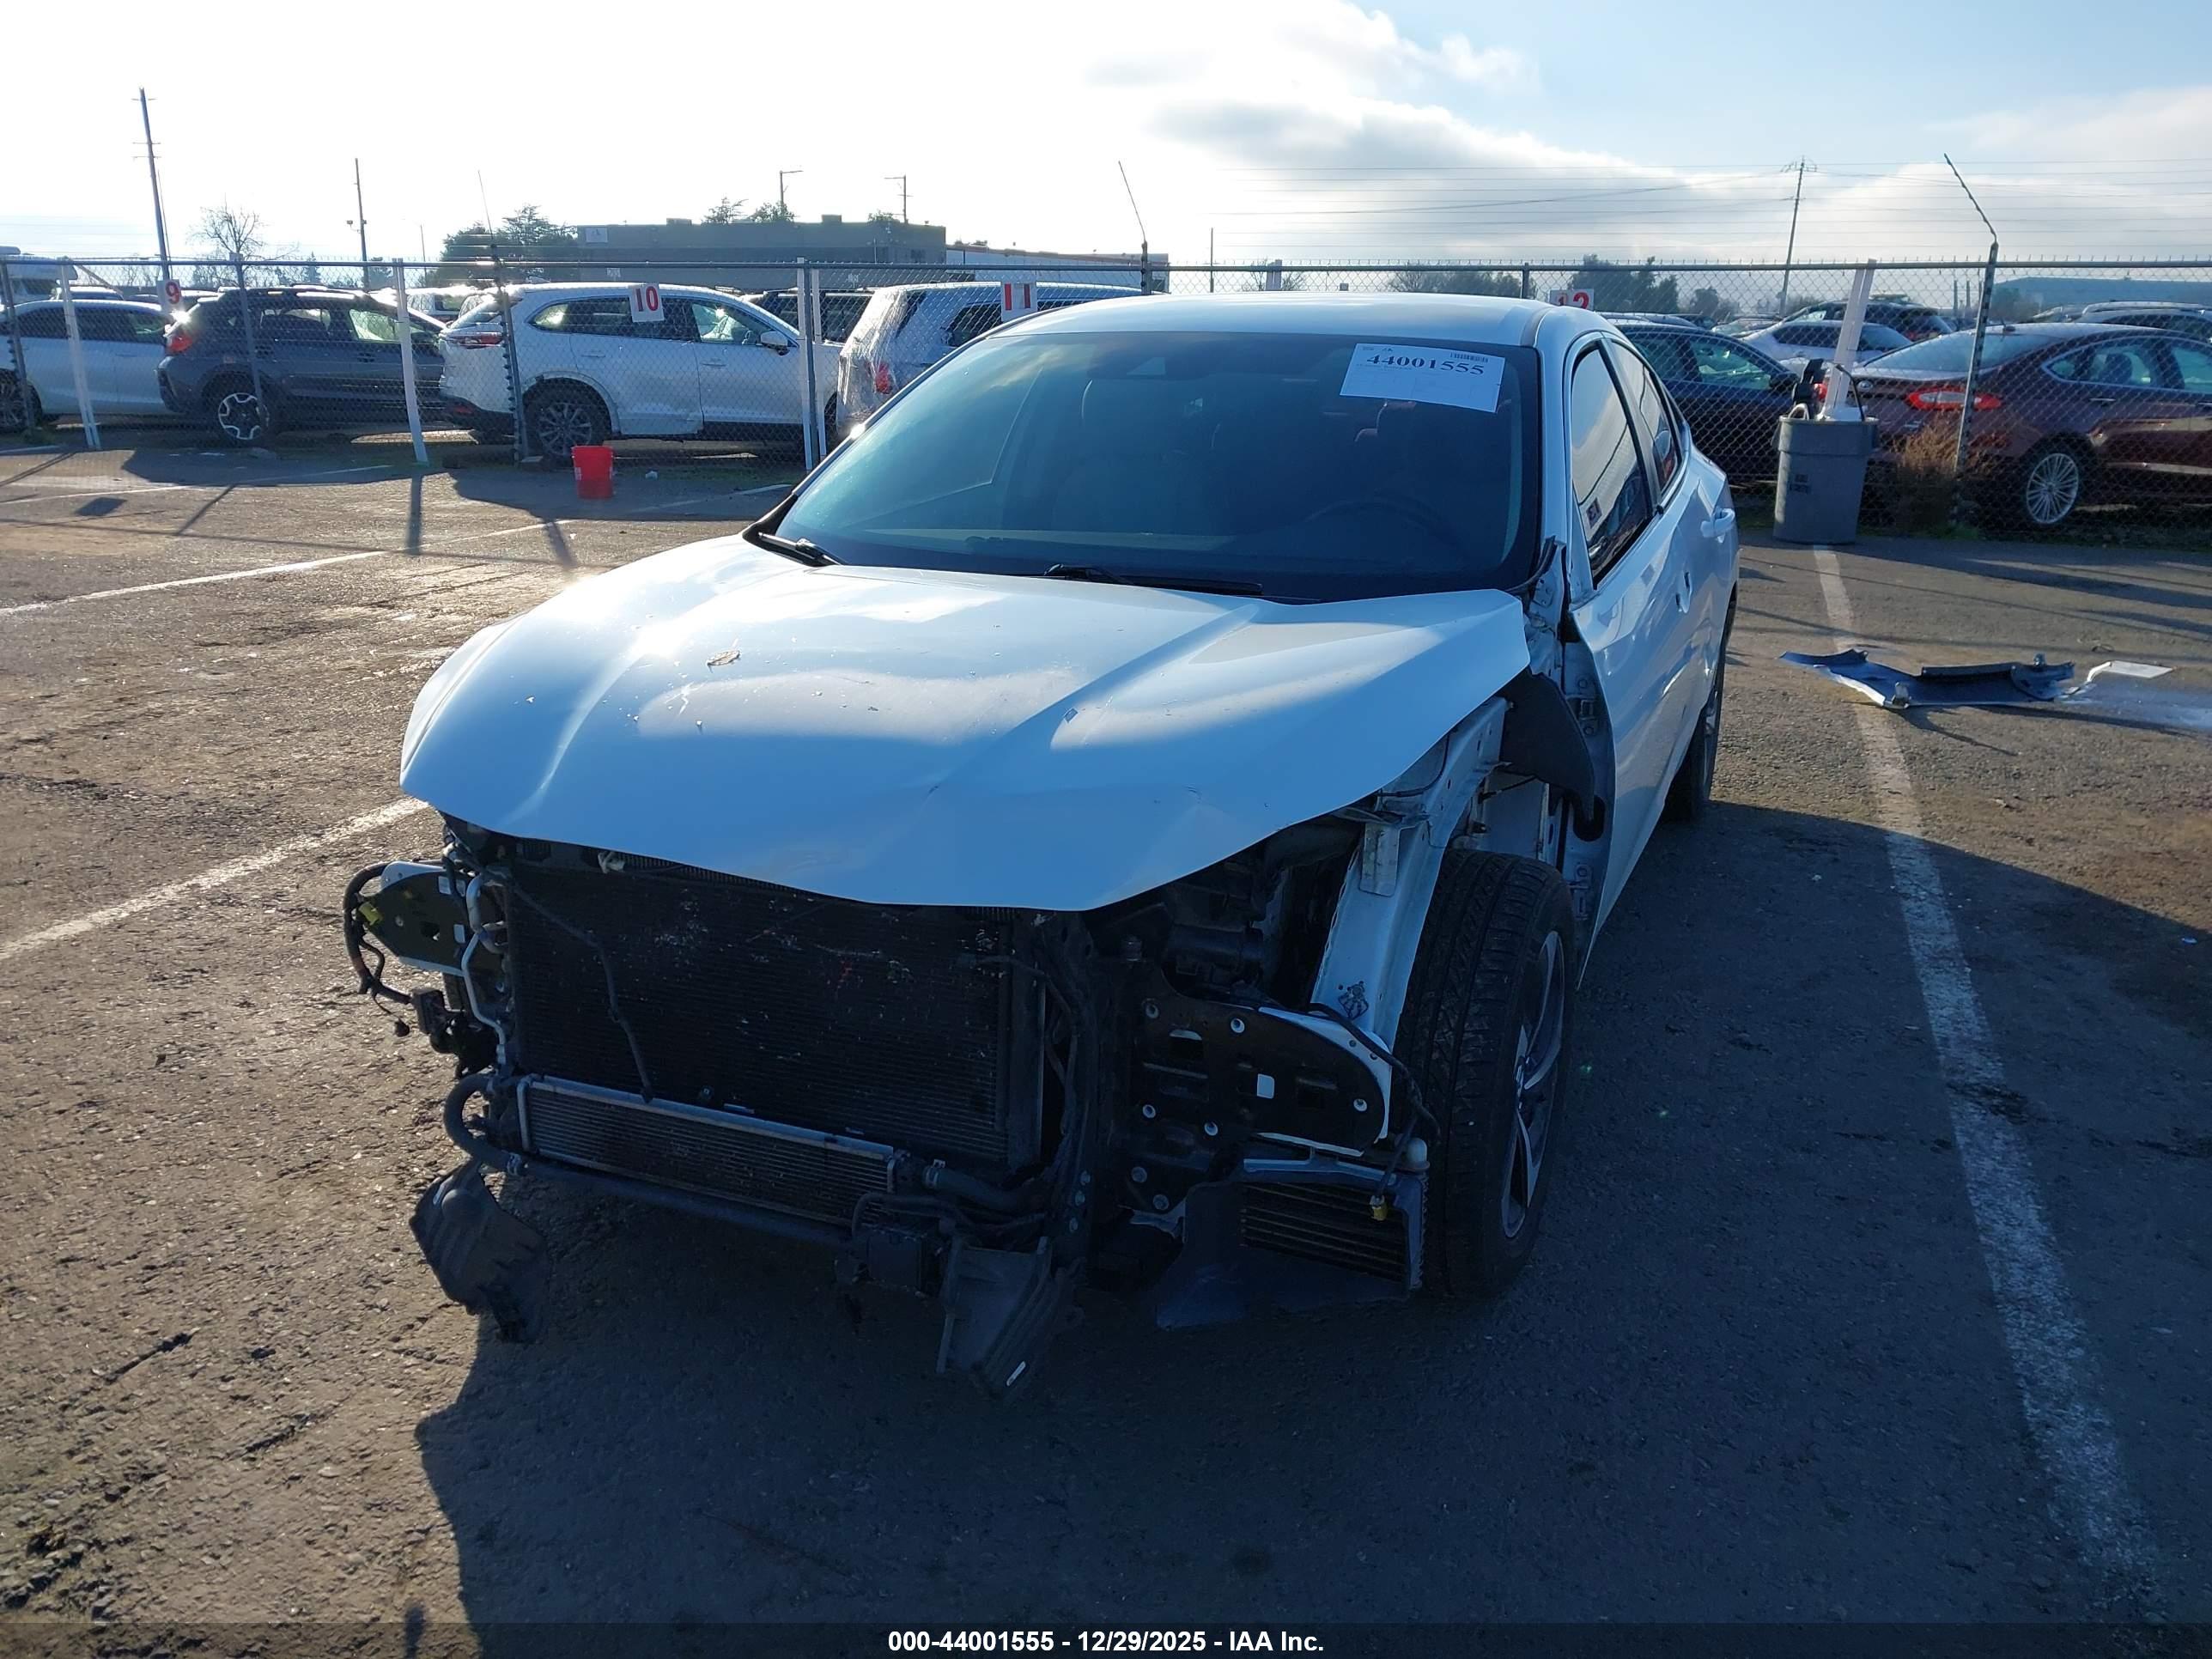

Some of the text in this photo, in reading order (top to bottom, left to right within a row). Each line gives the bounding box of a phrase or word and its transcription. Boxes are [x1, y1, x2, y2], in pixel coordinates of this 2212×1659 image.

[166, 281, 180, 304] 9
[635, 286, 659, 312] 10
[1004, 283, 1030, 310] 11
[1366, 354, 1485, 375] 44001555
